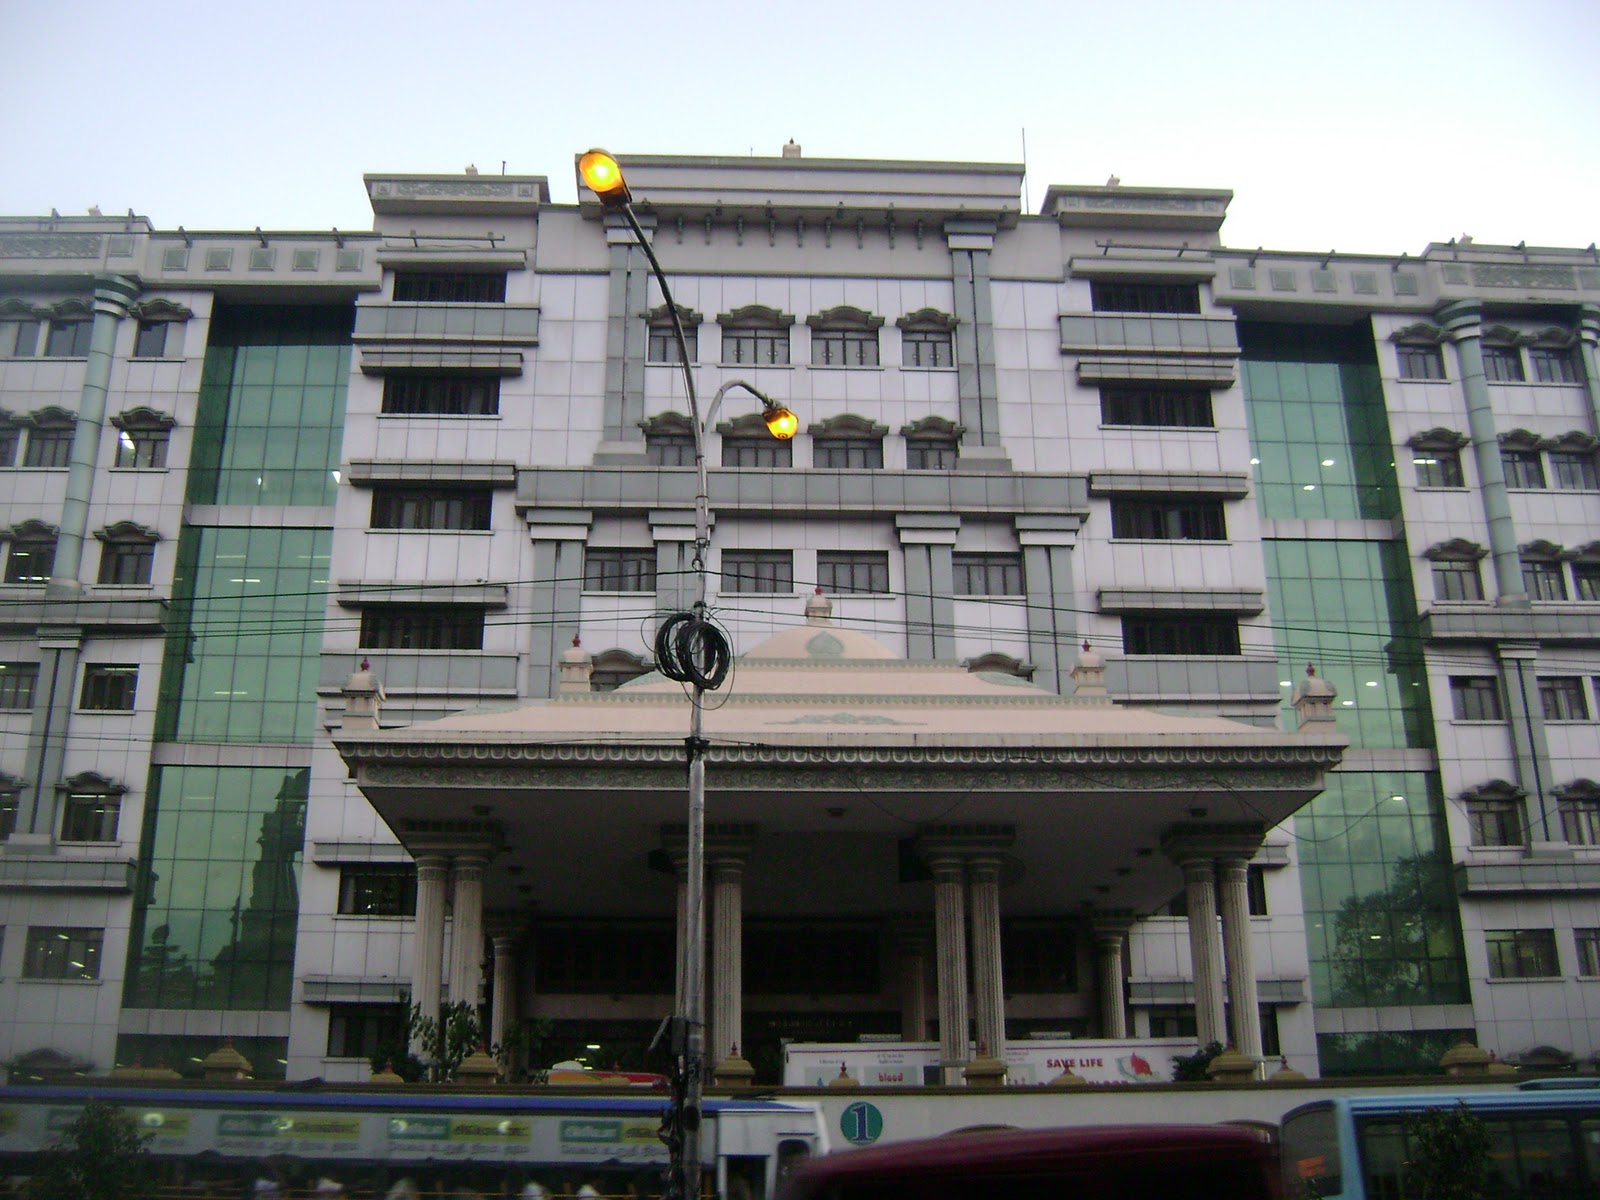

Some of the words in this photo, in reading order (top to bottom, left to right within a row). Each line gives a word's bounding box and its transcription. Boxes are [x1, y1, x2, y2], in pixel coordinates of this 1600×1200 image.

[1046, 1058, 1075, 1068] SAVE
[1079, 1058, 1103, 1067] LIFE
[878, 1072, 903, 1082] blood
[851, 1103, 873, 1142] 1
